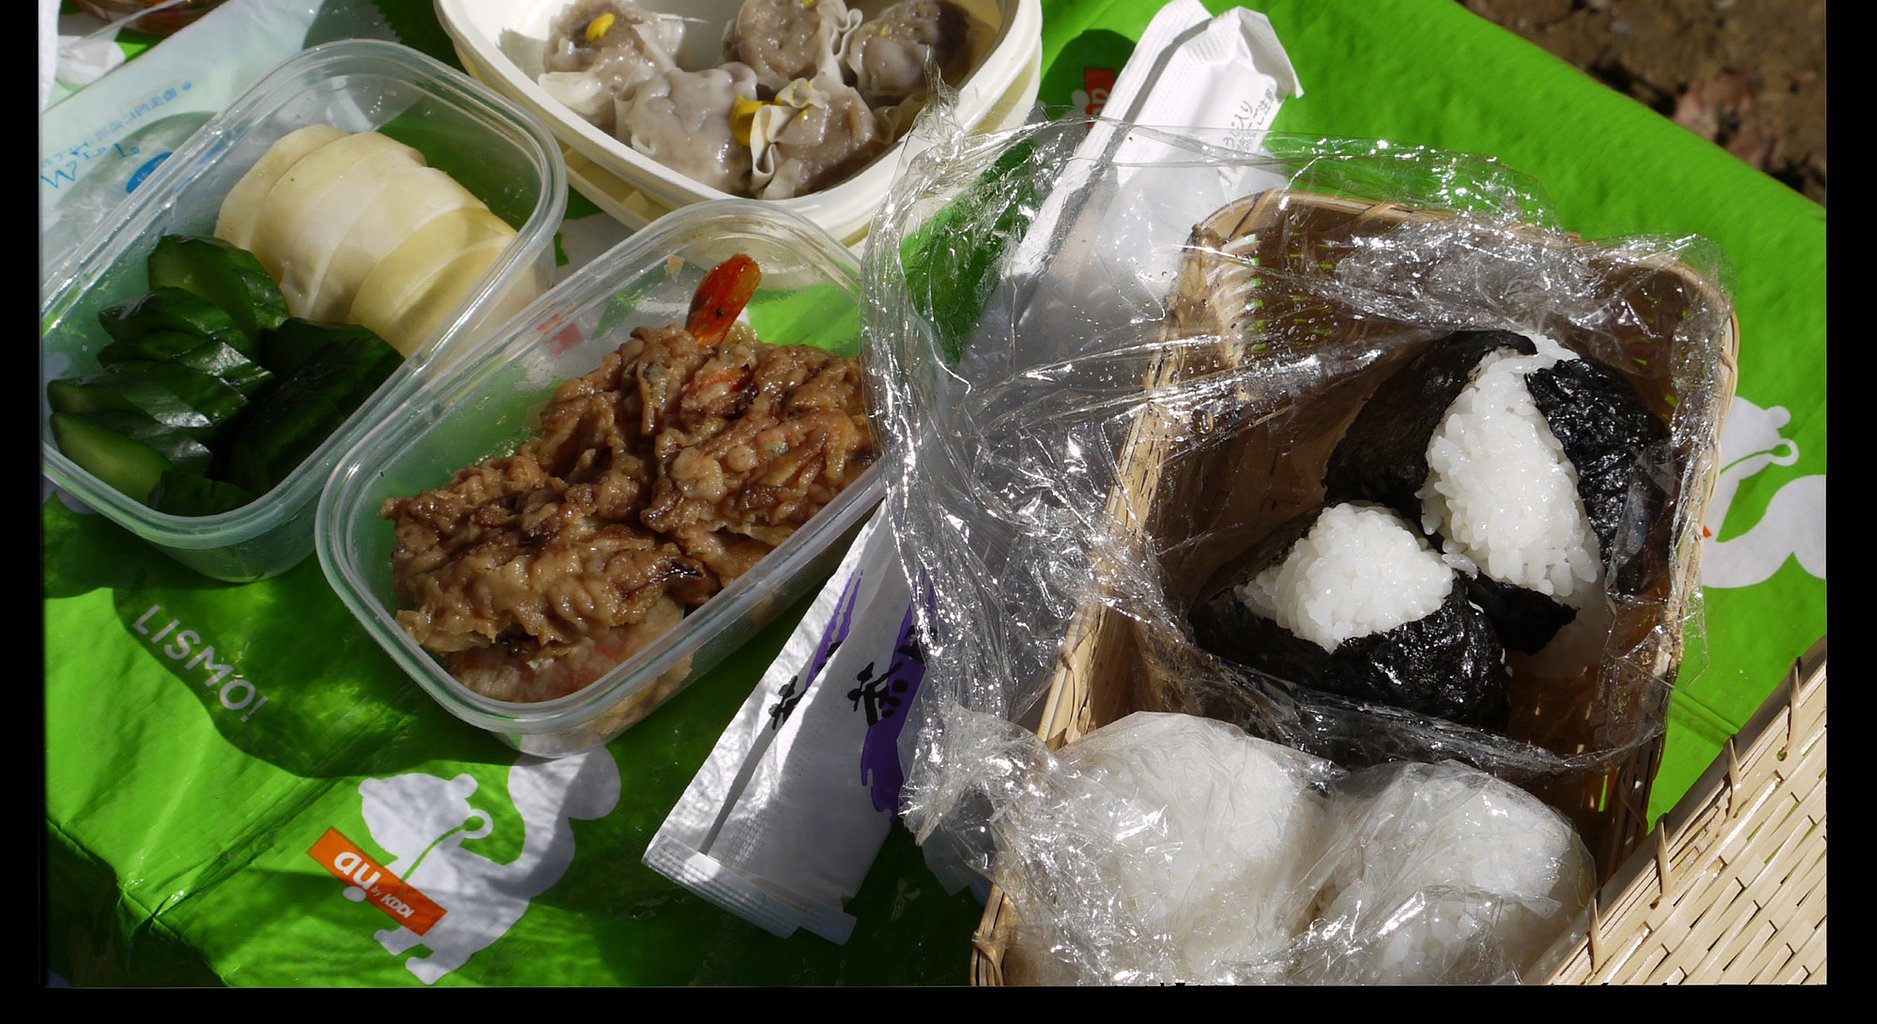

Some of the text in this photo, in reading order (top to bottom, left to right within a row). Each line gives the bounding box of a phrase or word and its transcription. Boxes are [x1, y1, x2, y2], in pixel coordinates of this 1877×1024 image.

[132, 604, 269, 722] LISMO!
[334, 851, 415, 918] au by KDDI
